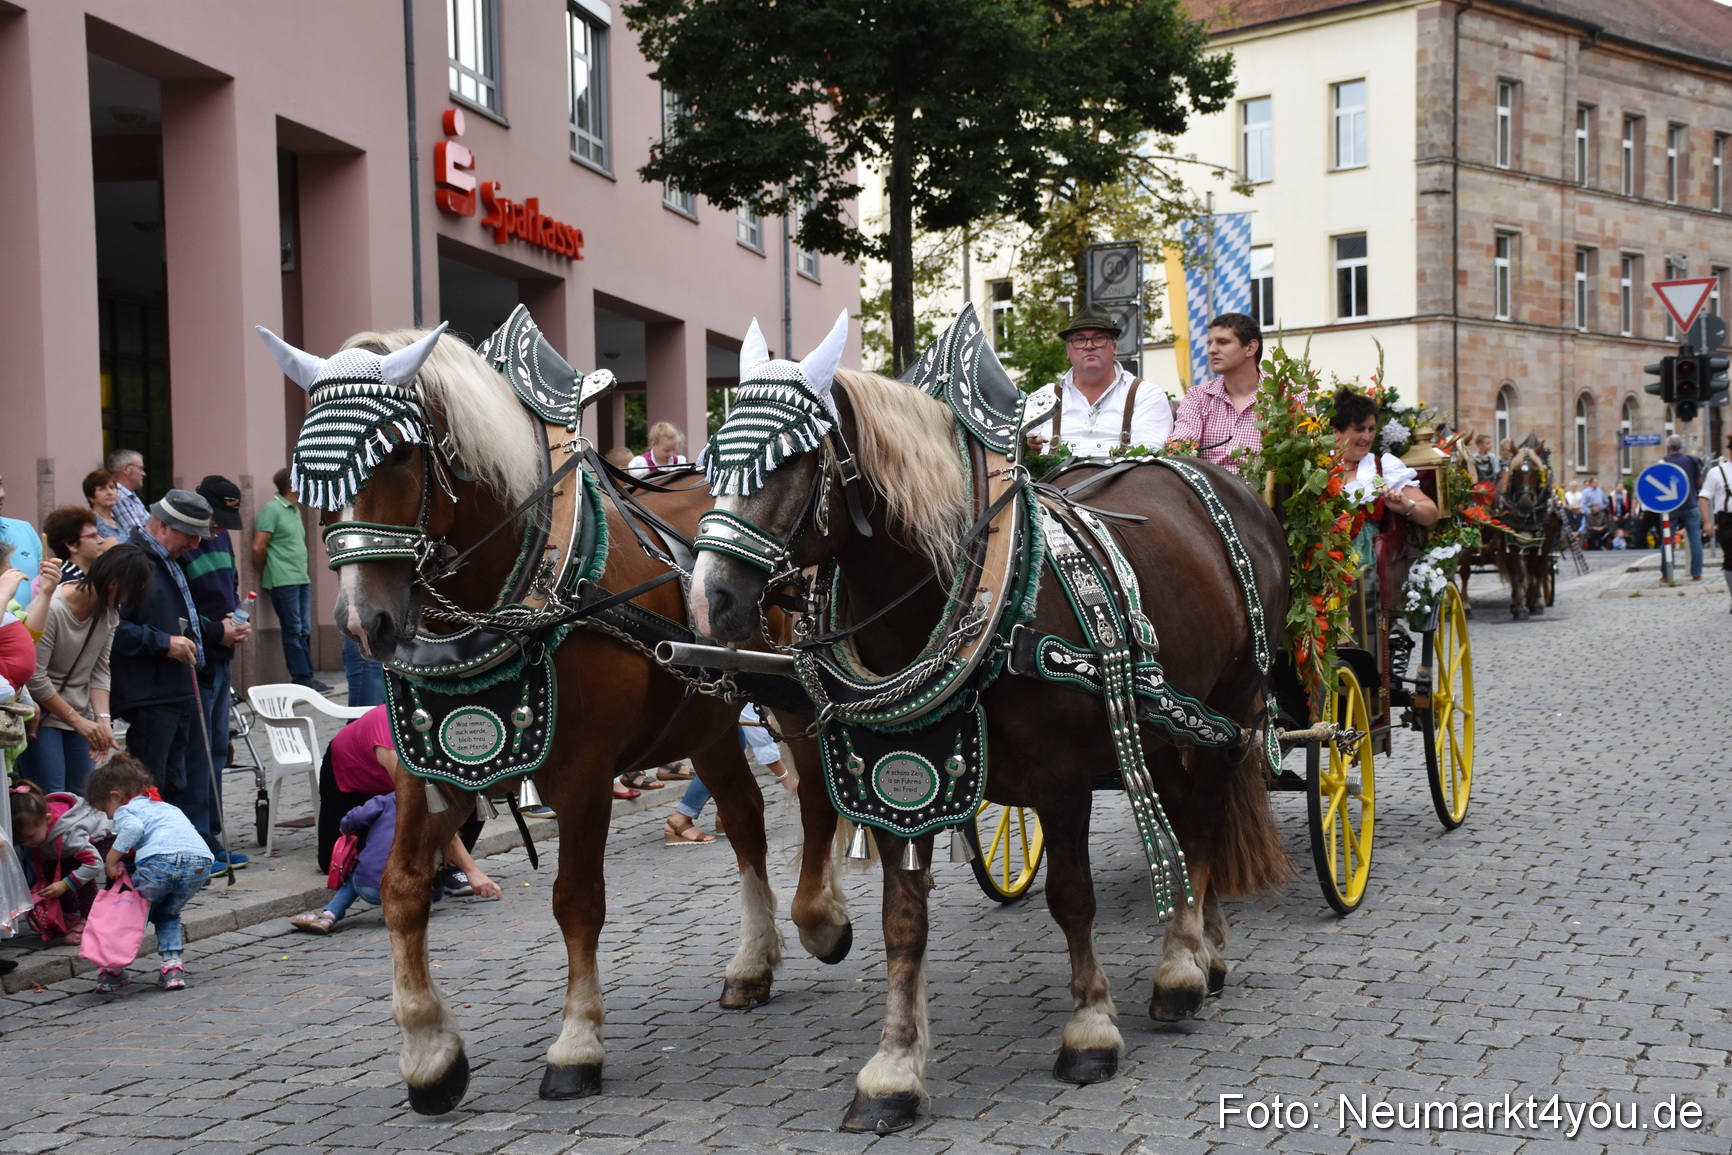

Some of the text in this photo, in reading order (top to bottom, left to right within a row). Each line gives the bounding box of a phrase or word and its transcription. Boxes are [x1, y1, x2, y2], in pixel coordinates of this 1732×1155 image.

[481, 181, 584, 261] Sparkasse
[1106, 261, 1124, 276] 30
[1104, 286, 1127, 297] ZONE
